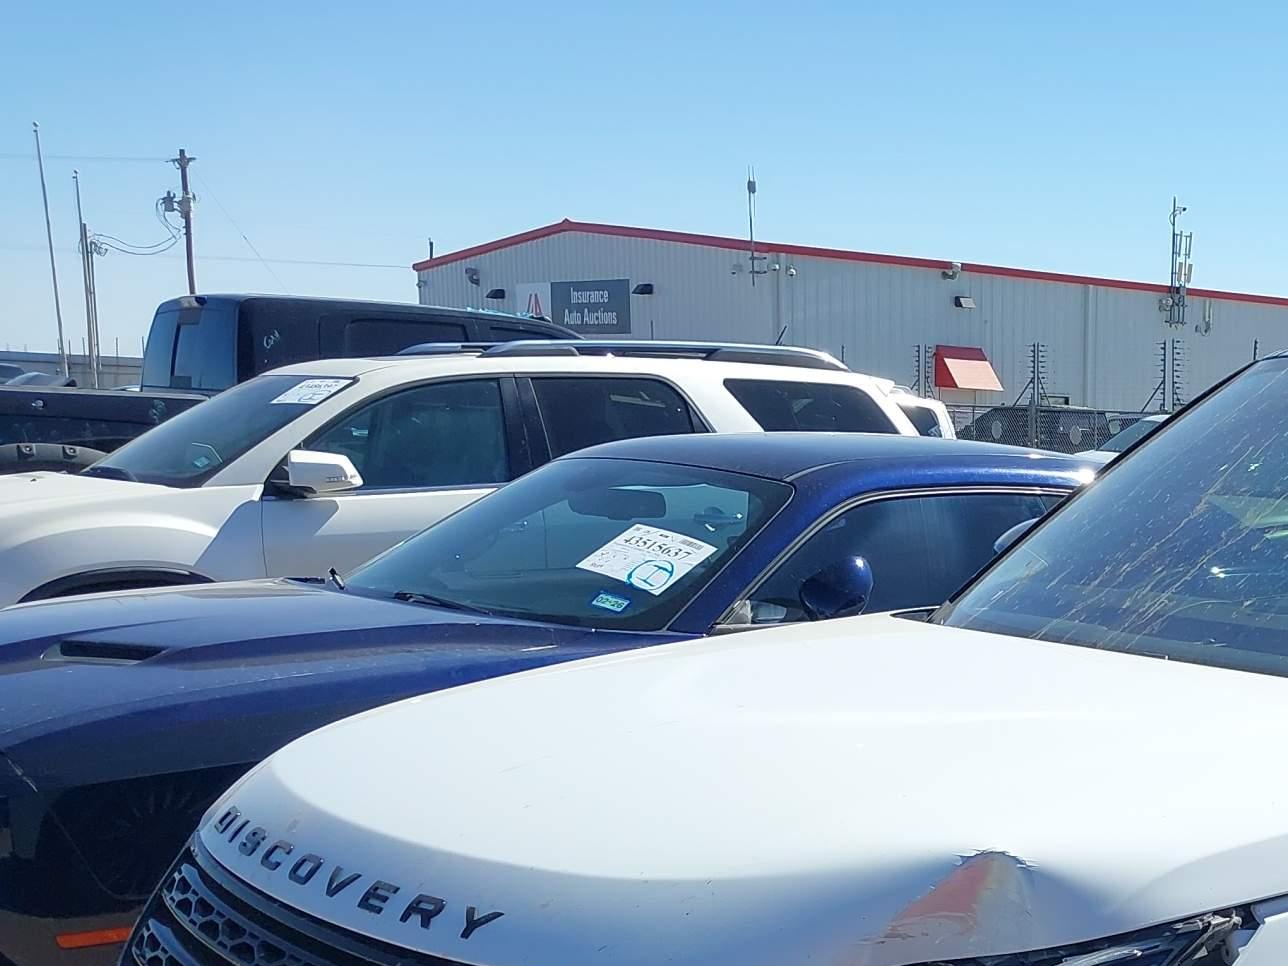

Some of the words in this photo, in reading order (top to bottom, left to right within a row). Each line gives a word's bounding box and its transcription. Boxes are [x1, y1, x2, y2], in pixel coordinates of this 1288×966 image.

[570, 287, 609, 304] Insurance
[564, 308, 581, 325] Auto
[583, 307, 618, 325] Auctions
[623, 535, 693, 561] 43515637
[213, 805, 505, 940] DISCOVERY
